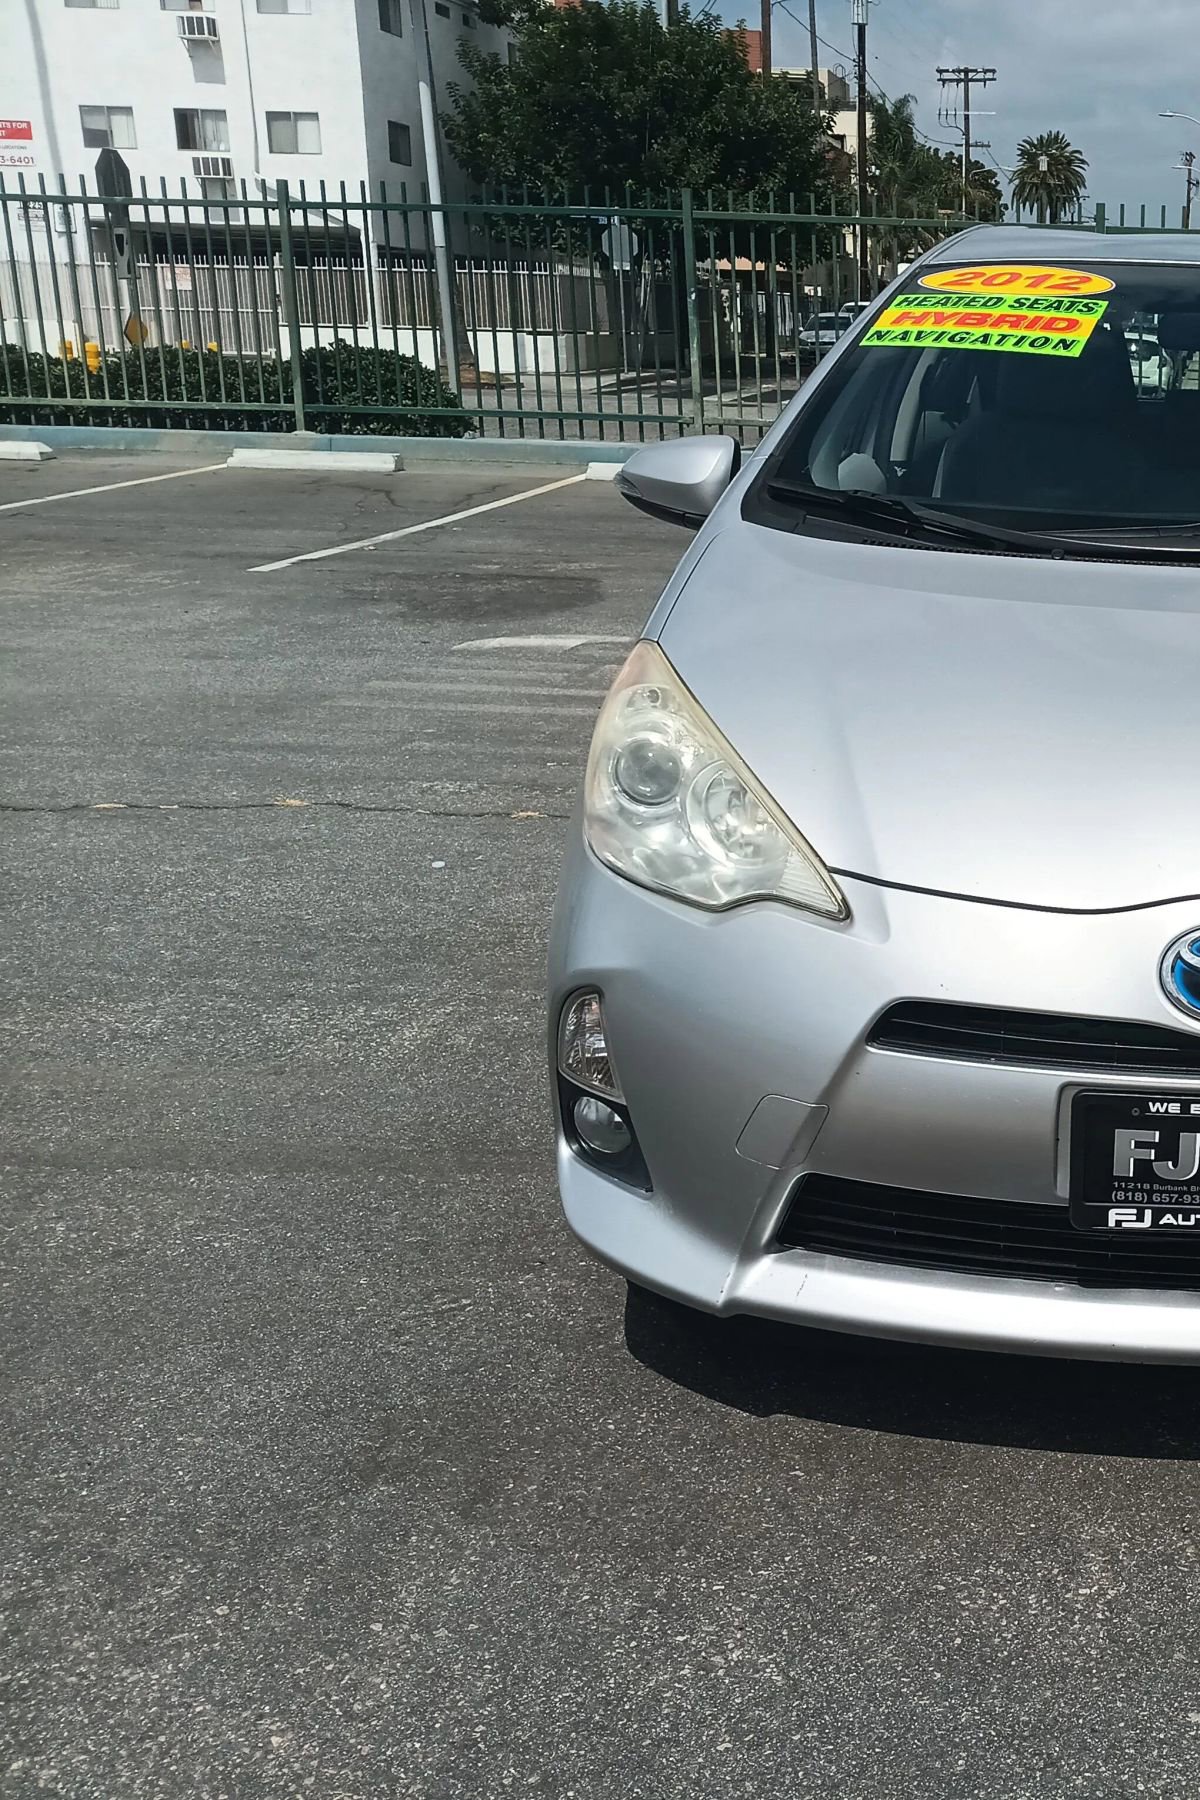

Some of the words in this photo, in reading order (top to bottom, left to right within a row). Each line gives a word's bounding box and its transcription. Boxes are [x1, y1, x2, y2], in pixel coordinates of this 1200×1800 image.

[943, 271, 1092, 291] 2012
[894, 296, 1008, 310] HEATED
[1007, 297, 1102, 314] SEATS
[889, 311, 1083, 333] HYBRID
[866, 330, 1080, 351] NAVIGATION
[1148, 1101, 1181, 1114] WE
[1112, 1128, 1200, 1181] FJ
[1111, 1190, 1148, 1203] (818)
[1153, 1183, 1188, 1191] Burbank
[1108, 1208, 1152, 1228] FJ
